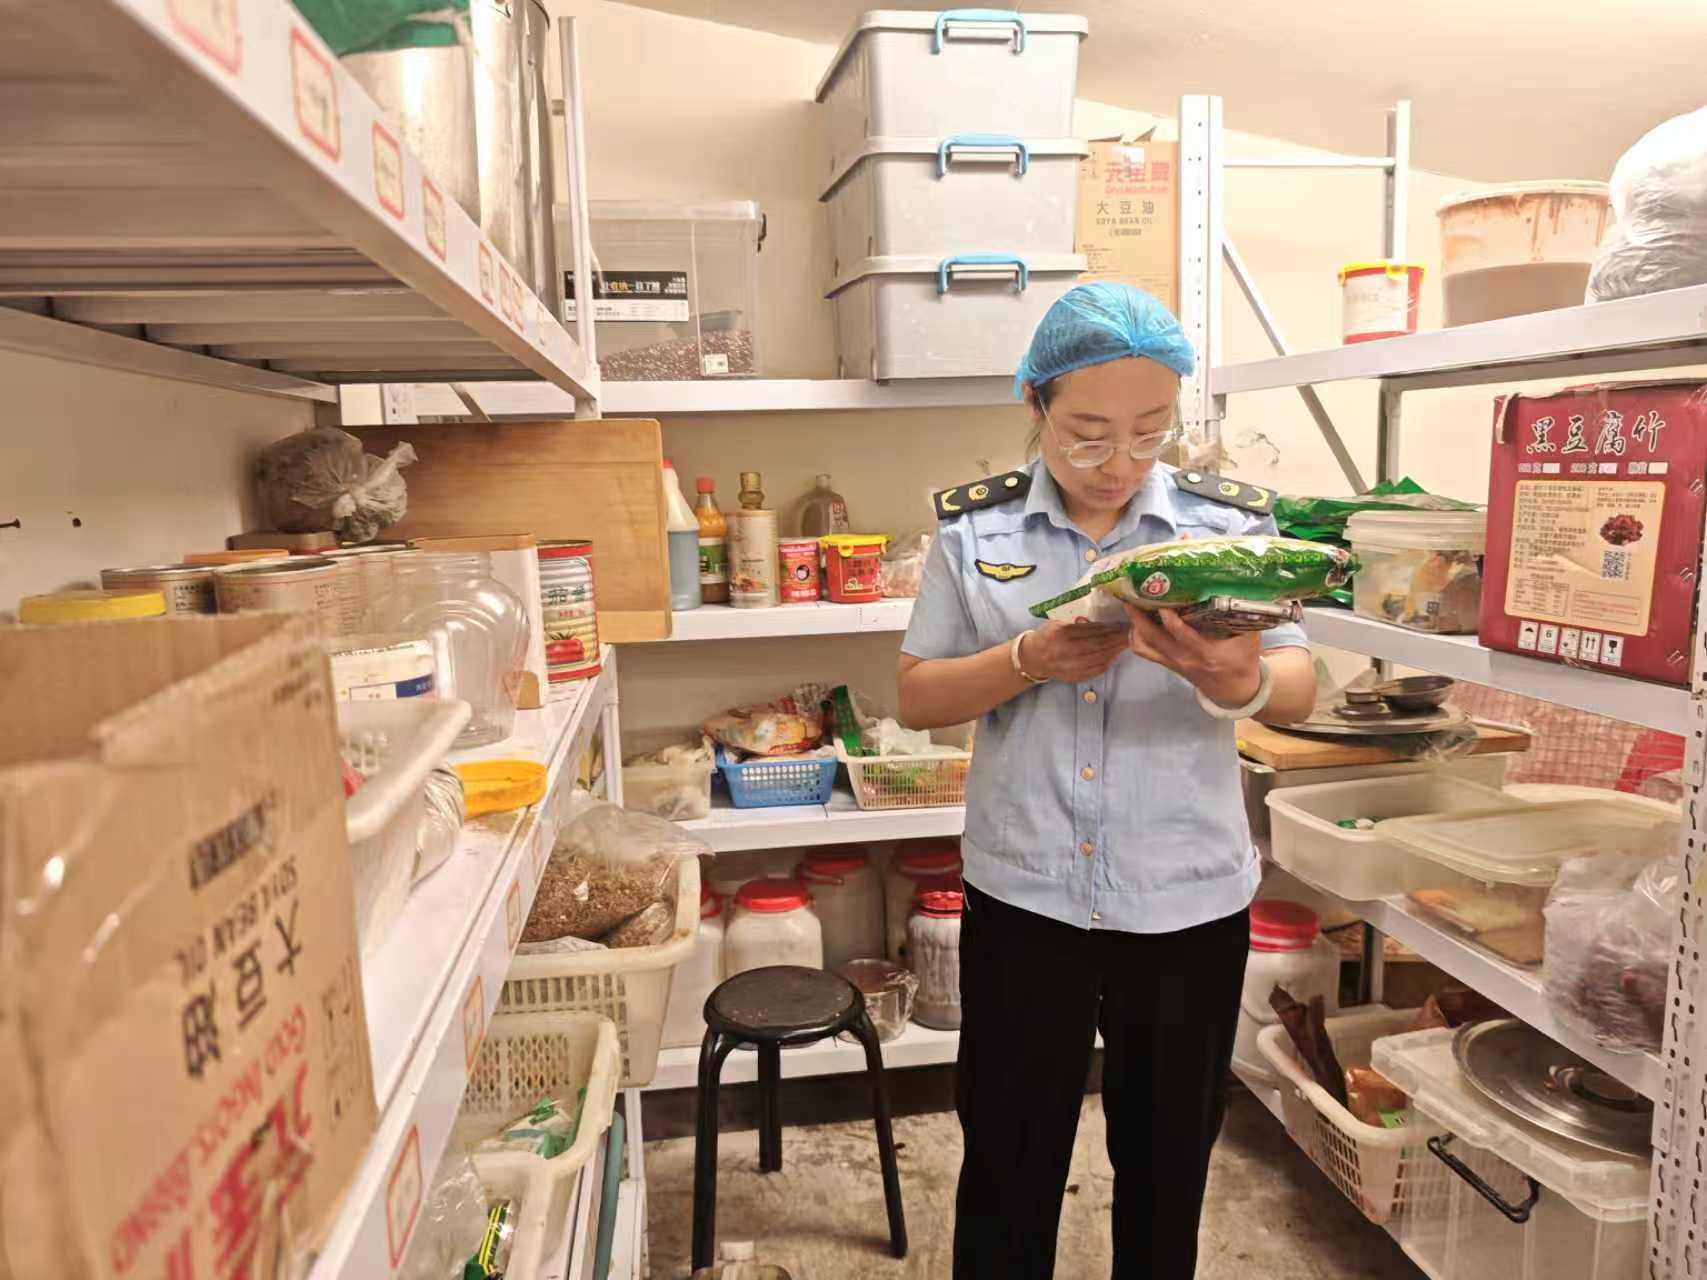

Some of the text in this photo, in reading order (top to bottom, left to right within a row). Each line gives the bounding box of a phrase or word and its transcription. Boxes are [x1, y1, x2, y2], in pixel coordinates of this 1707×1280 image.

[1096, 200, 1155, 216] 大豆油
[1526, 410, 1666, 455] 黑豆腐竹
[182, 897, 302, 1080] 大豆油
